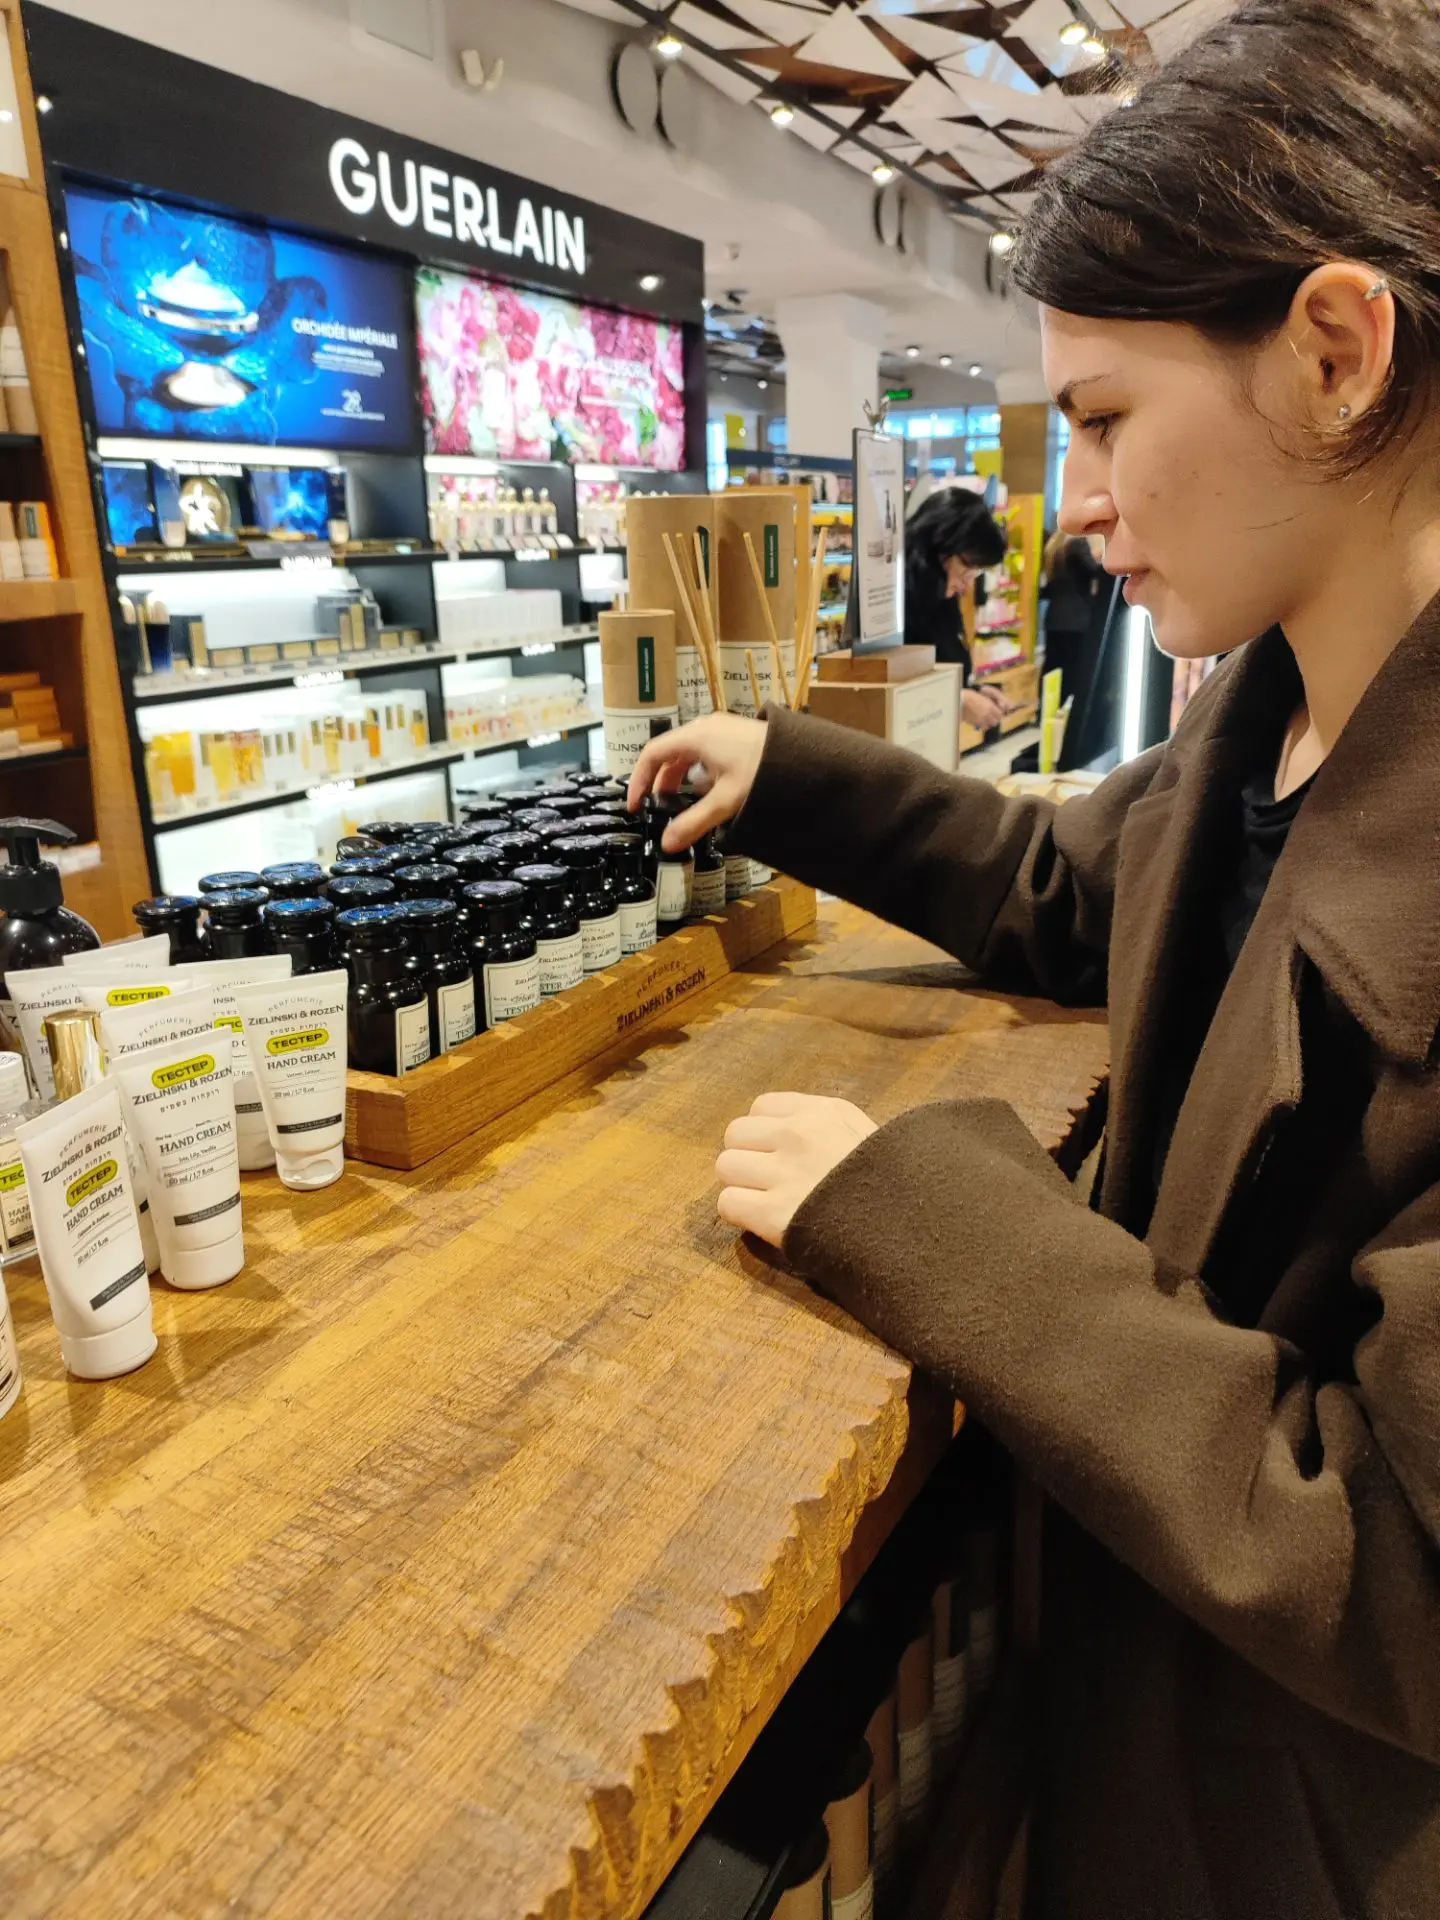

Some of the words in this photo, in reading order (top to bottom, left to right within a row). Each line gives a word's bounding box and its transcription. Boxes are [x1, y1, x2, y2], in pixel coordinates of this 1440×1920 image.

[328, 137, 586, 275] GUERLAIN
[666, 987, 674, 1001] &
[675, 966, 706, 997] ROZEN
[19, 998, 72, 1011] ZIELINSKI
[247, 1011, 298, 1026] ZIELINSKI
[299, 1010, 308, 1019] &
[310, 1004, 345, 1018] ROZEN
[119, 1036, 168, 1054] ZIELINSKI
[170, 1032, 178, 1041] &
[180, 1021, 213, 1037] ROZEN
[272, 1033, 323, 1049] ТЕСТЕР
[157, 1060, 208, 1084] ТЕСТЕР
[267, 1057, 298, 1070] HAND
[299, 1051, 336, 1063] CREAM
[132, 1082, 188, 1106] ZIELINSKI
[199, 1065, 233, 1085] ROZEN
[159, 1136, 195, 1154] HAND
[196, 1121, 232, 1141] CREAM
[41, 1149, 84, 1184] ZIELINSKI
[84, 1142, 92, 1152] &
[70, 1166, 112, 1199] ТЕСТЕР
[8, 1205, 30, 1217] HAN
[66, 1207, 89, 1231] HAND
[89, 1184, 124, 1212] CREAM
